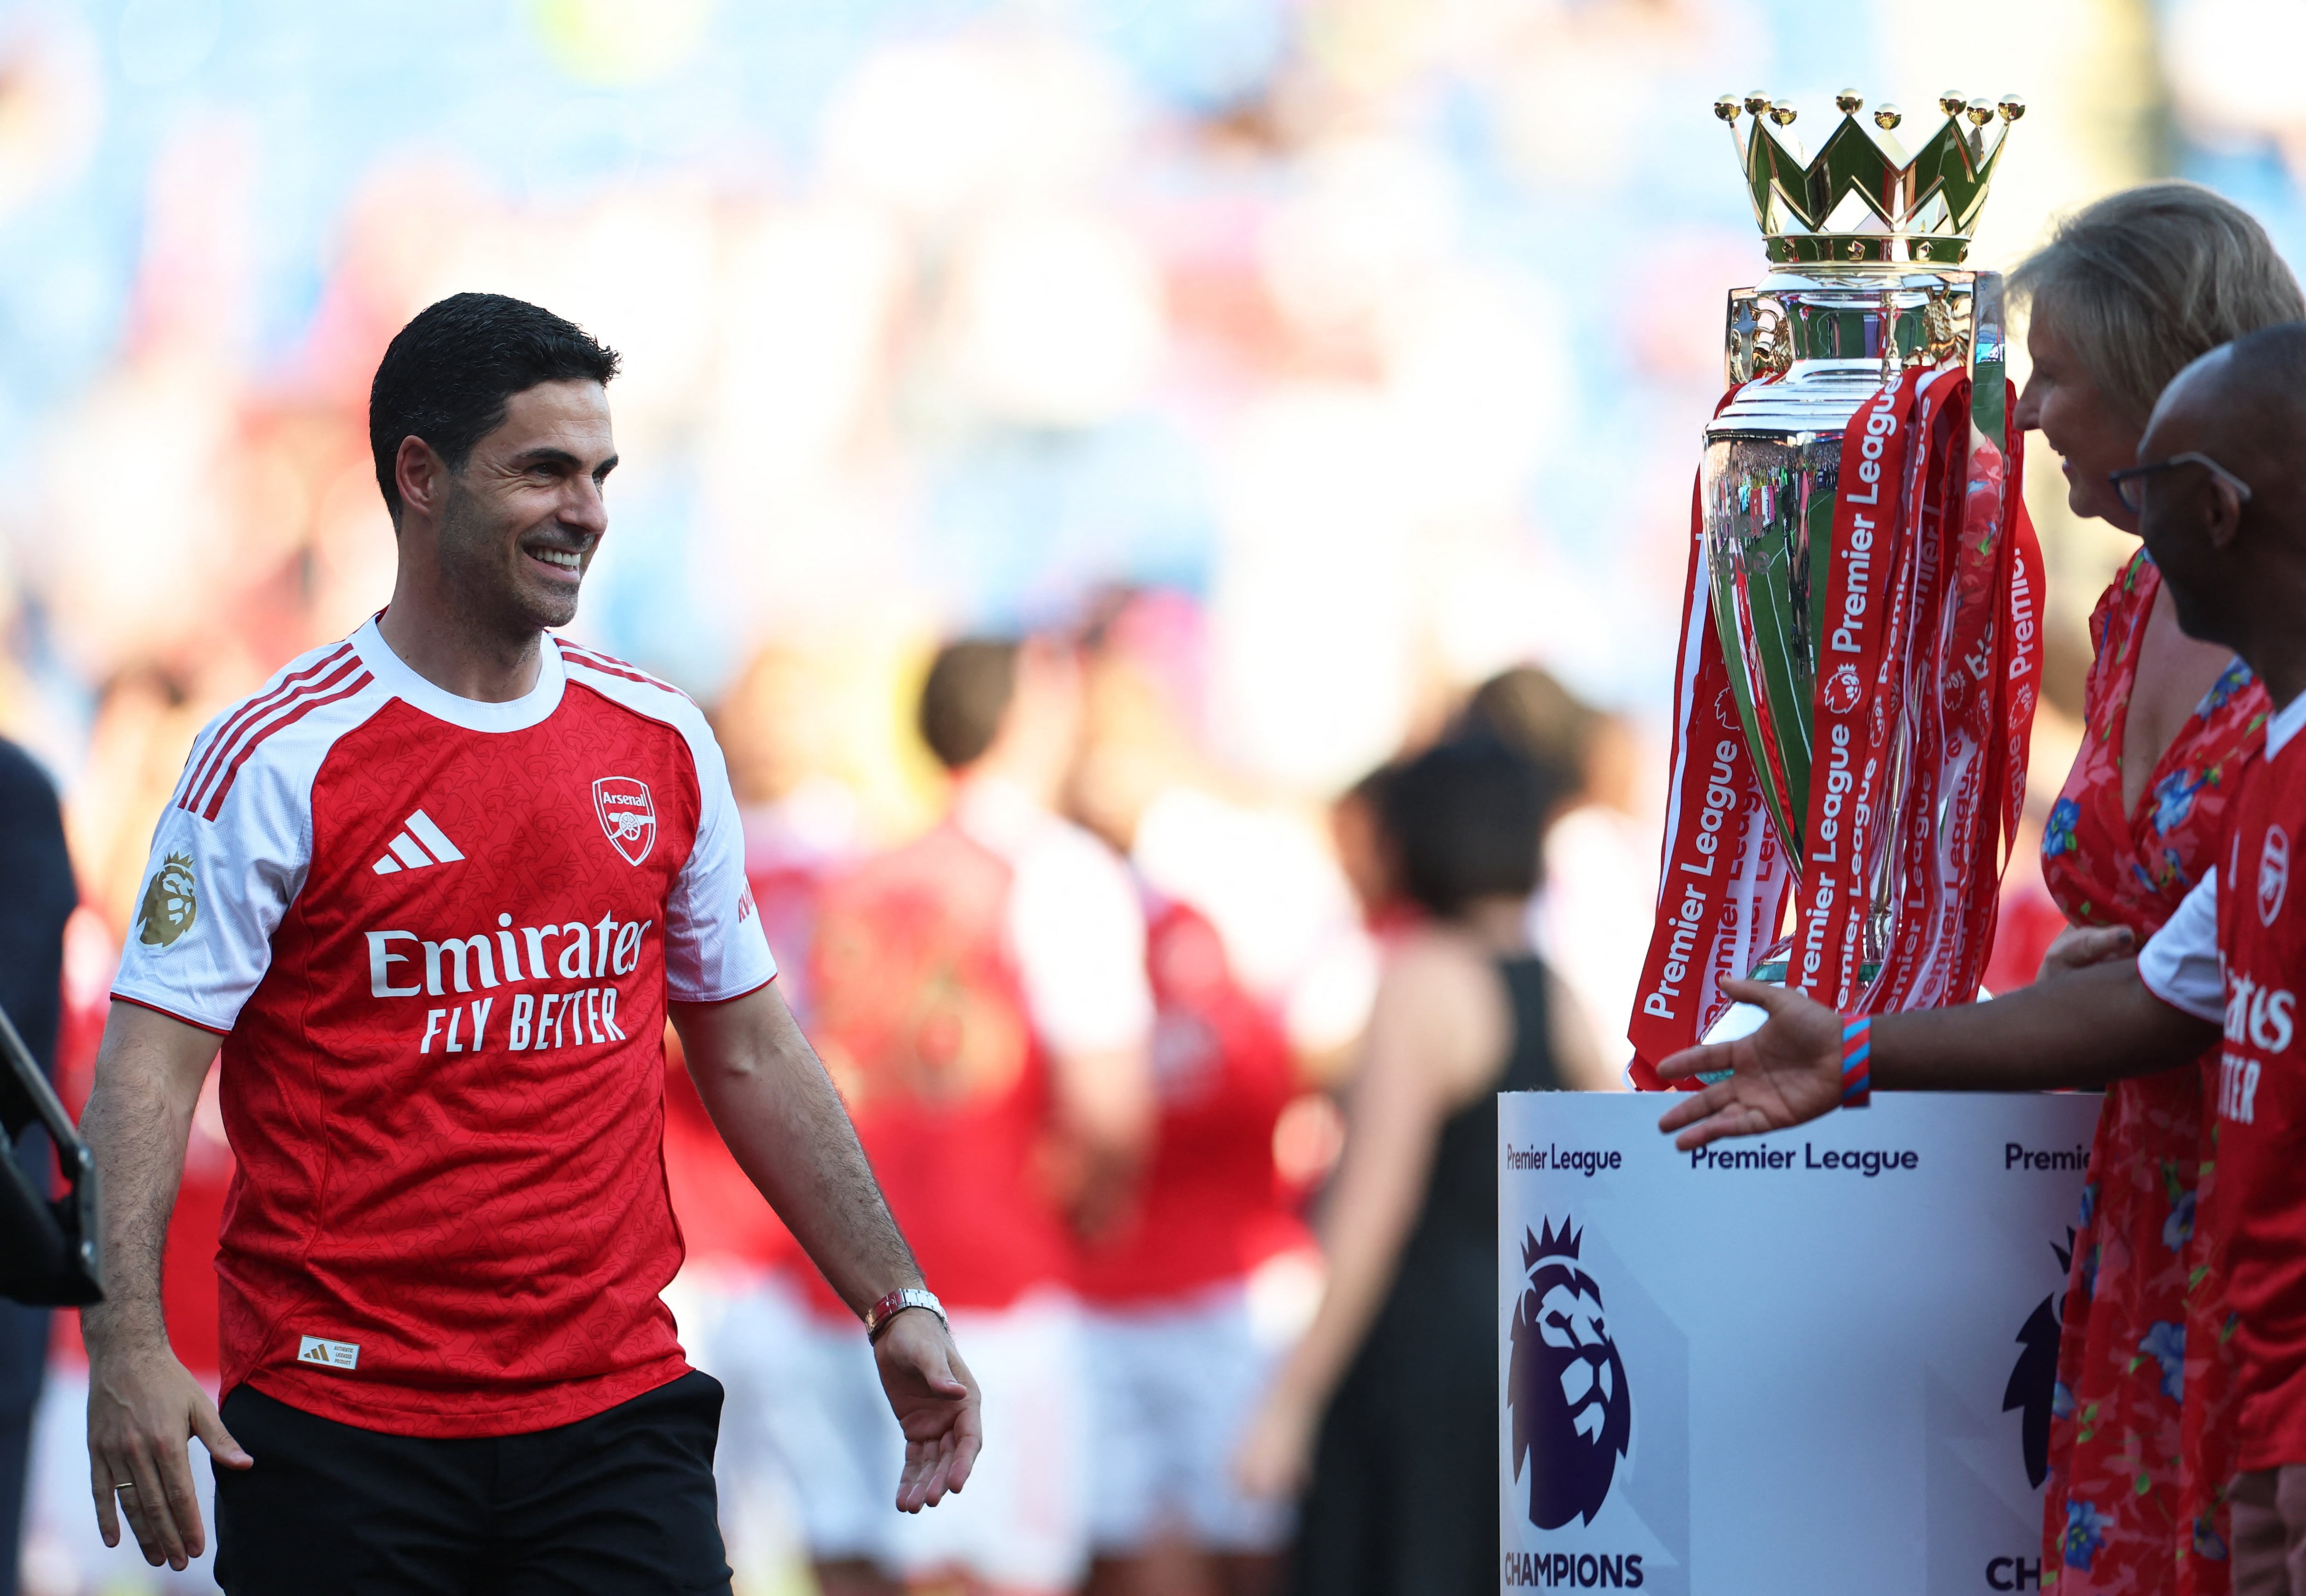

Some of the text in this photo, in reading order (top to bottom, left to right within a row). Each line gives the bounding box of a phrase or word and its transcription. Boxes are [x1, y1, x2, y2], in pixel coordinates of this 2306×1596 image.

[1705, 515, 1765, 539] emier
[1832, 376, 1902, 653] Premier League
[1708, 552, 1771, 586] eague
[1878, 546, 1909, 684] Premier
[603, 792, 646, 807] Arsenal
[1813, 724, 1852, 862] League
[1644, 740, 1738, 1020] Premier League
[1836, 757, 1877, 1014] emier League
[1884, 919, 1921, 1015] emier
[1908, 771, 1932, 908] League
[364, 910, 652, 997] Emirates
[421, 988, 626, 1054] FLY BETTER
[1507, 1143, 1622, 1177] Premier League
[1691, 1142, 1919, 1177] Premier League
[2005, 1142, 2091, 1170] Premi
[1505, 1552, 1644, 1588] CHAMPIONS
